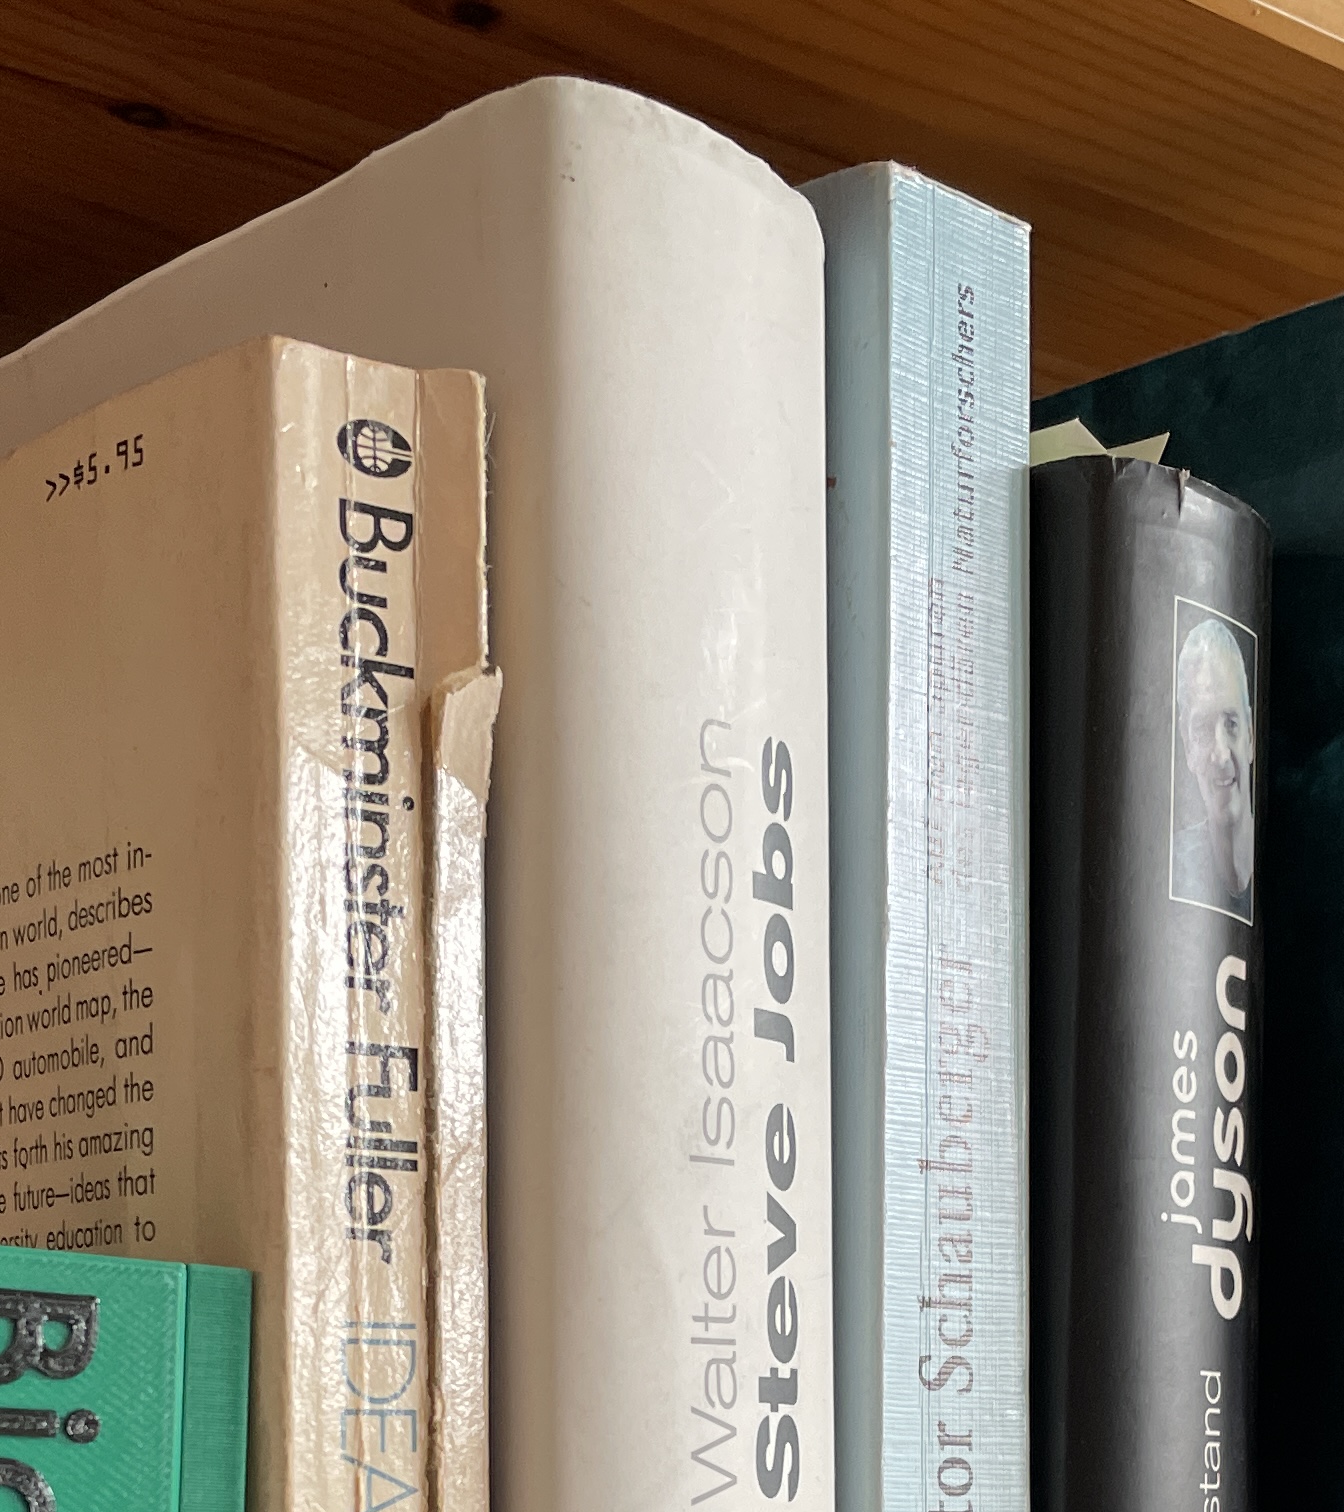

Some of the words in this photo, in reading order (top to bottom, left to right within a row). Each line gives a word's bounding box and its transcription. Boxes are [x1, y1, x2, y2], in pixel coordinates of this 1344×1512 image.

[950, 281, 975, 576] Naturforschers
[338, 497, 415, 1016] Buckminster
[14, 906, 64, 949] world,
[68, 887, 153, 932] describes
[27, 866, 43, 898] of
[48, 866, 71, 892] the
[78, 848, 118, 885] most
[127, 842, 152, 872] in-
[688, 717, 736, 1168] Isaacson
[751, 735, 796, 1064] Jobs
[13, 1038, 104, 1080] automobile,
[115, 1023, 153, 1058] and
[14, 961, 39, 990] has
[28, 997, 71, 1034] world
[76, 990, 117, 1025] map,
[122, 979, 153, 1010] the
[9, 1089, 44, 1124] have
[49, 1076, 117, 1119] changed
[124, 1073, 153, 1102] the
[13, 1132, 48, 1170] forth
[53, 1128, 73, 1161] his
[78, 1122, 153, 1157] amazing
[118, 1172, 155, 1198] that
[343, 1039, 419, 1266] Fuller
[915, 948, 989, 1392] Schauberger
[1160, 1028, 1203, 1236] james
[1191, 953, 1254, 1320] dyson
[47, 1222, 122, 1250] education
[135, 1218, 155, 1241] to
[755, 1103, 800, 1503] Steve
[689, 1204, 738, 1507] Walter
